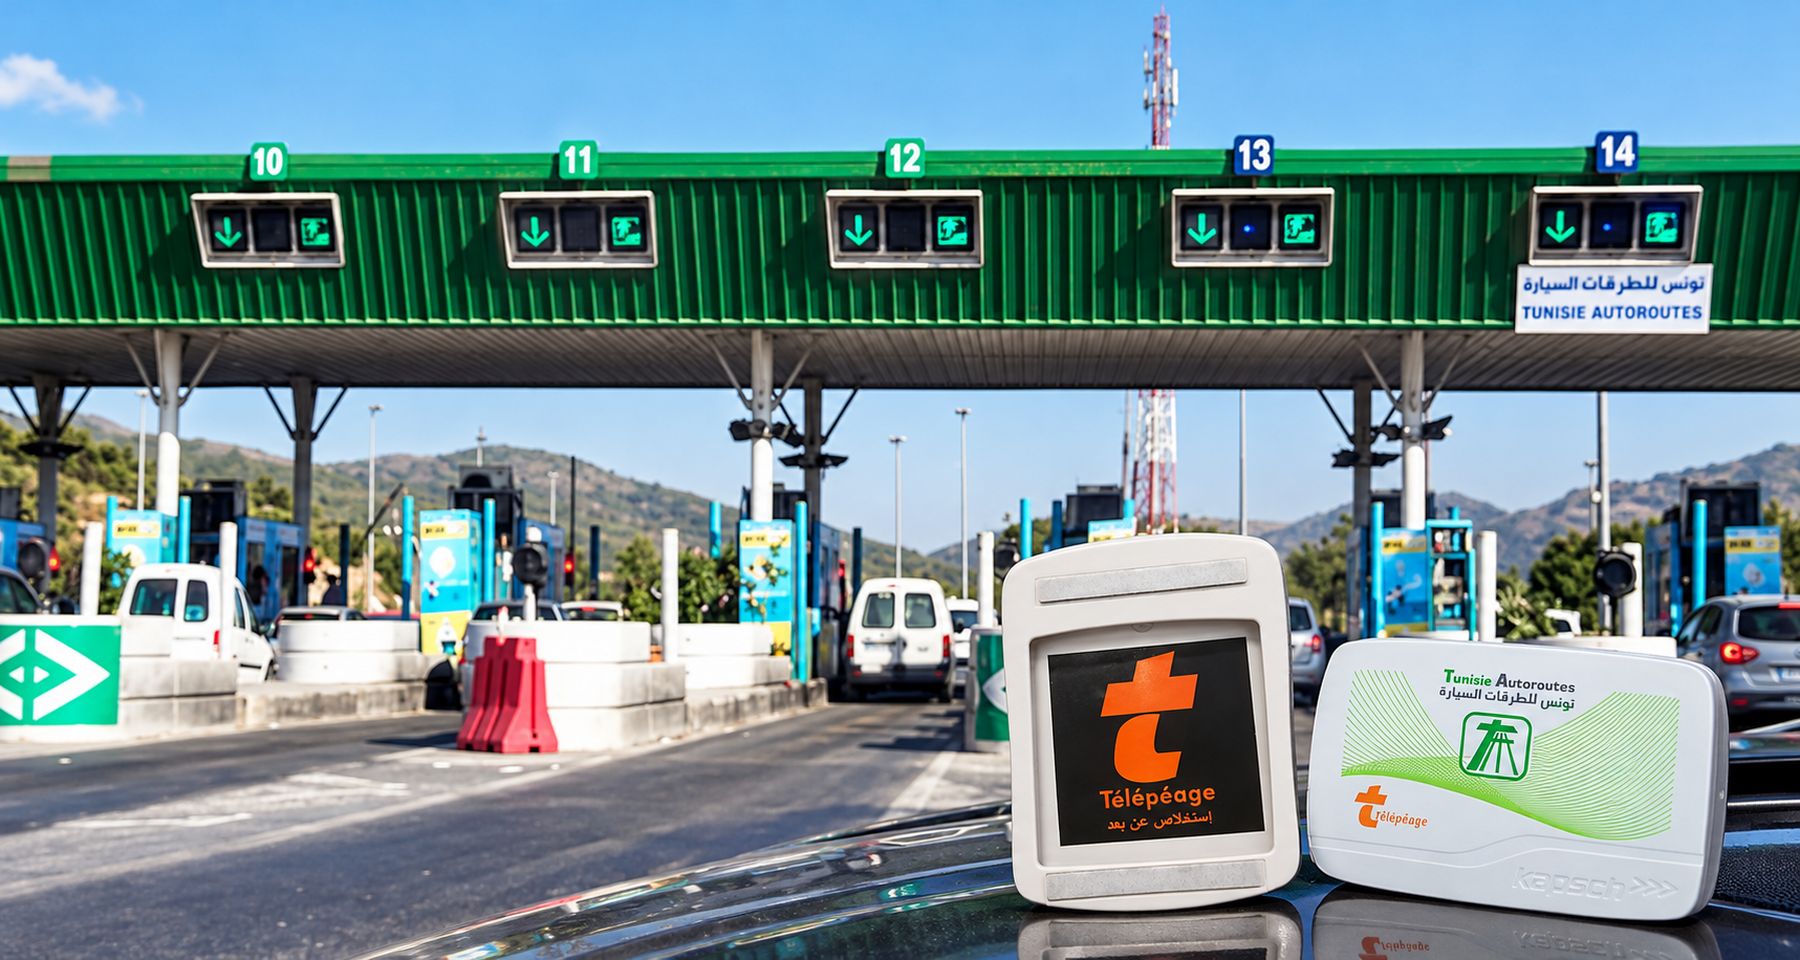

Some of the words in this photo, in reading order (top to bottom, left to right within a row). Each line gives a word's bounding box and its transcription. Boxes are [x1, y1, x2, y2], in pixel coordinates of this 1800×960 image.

[564, 145, 591, 174] 11
[890, 142, 921, 172] 12
[1239, 138, 1271, 171] 13
[1600, 134, 1636, 167] 14
[253, 146, 283, 176] 10
[1523, 276, 1578, 294] السيارة
[1582, 275, 1658, 295] للطرقات
[1661, 276, 1705, 293] تونس
[1522, 305, 1586, 319] TUNISIE
[1591, 305, 1703, 319] AUTOROUTES
[1443, 668, 1492, 686] Tunisie
[1495, 673, 1576, 693] Autoroutes
[1439, 686, 1482, 701] السيارة
[1484, 690, 1538, 706] للطرقات
[1540, 697, 1576, 712] تونس
[1099, 785, 1216, 811] Télépéage
[1107, 820, 1126, 833] بعد
[1129, 817, 1149, 831] عن
[1153, 810, 1213, 829] إستخلاص
[1512, 867, 1626, 902] kapsch
